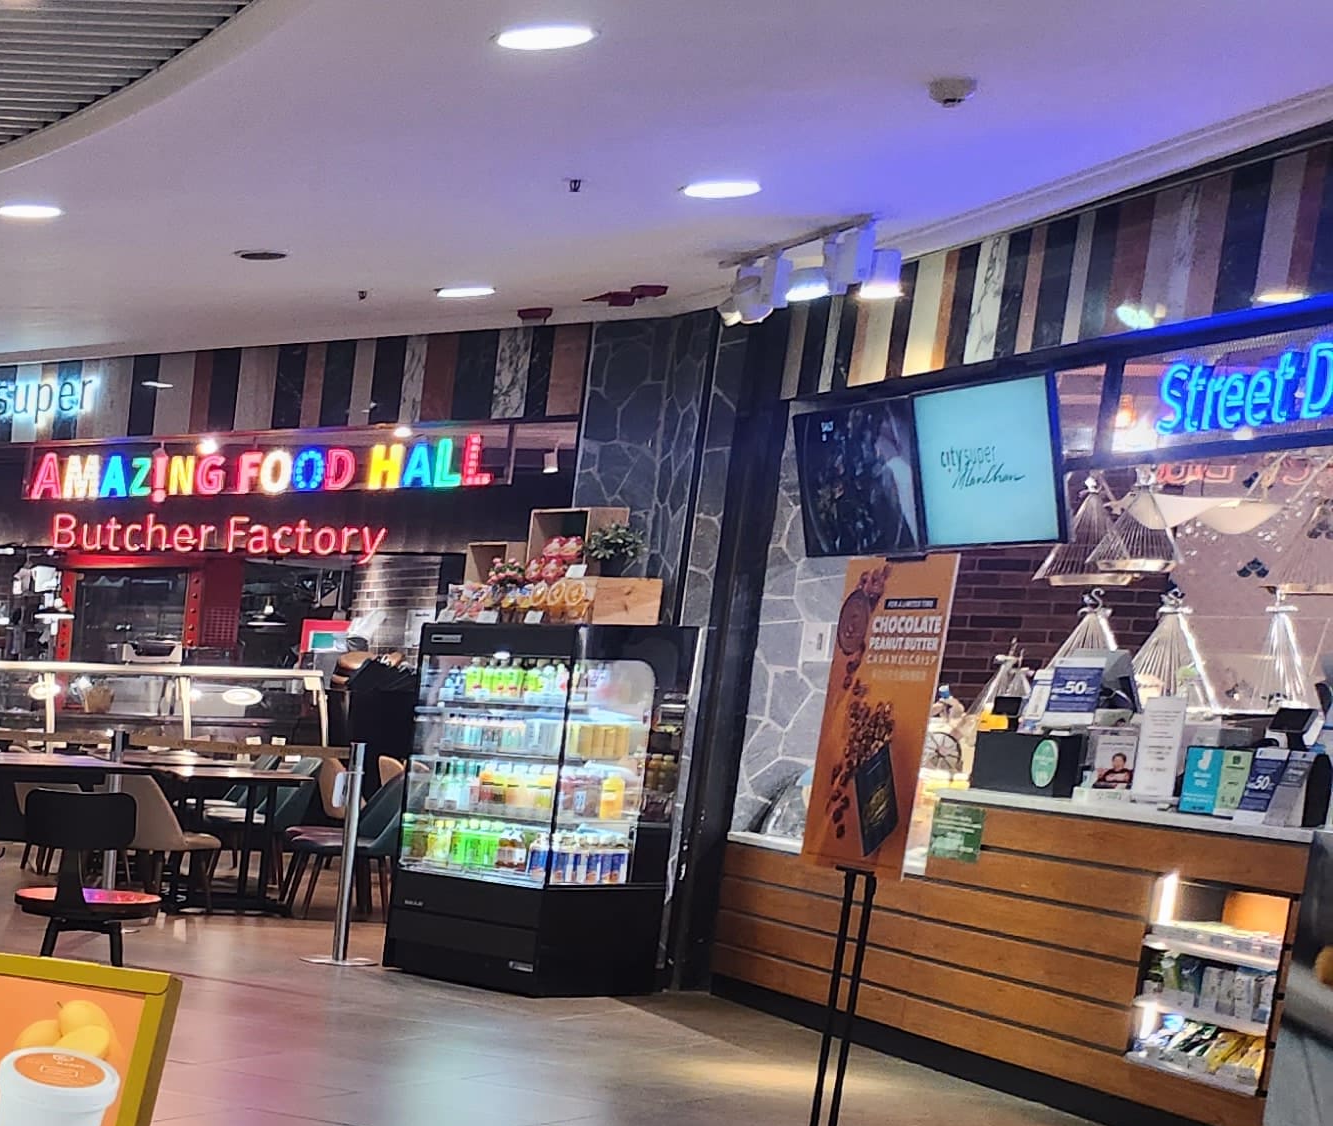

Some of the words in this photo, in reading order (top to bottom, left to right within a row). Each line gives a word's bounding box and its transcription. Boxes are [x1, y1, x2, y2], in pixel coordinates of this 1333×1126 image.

[1156, 350, 1296, 435] Street
[236, 447, 356, 495] FOOD
[368, 432, 493, 490] HALL
[52, 512, 216, 553] Butcher
[225, 515, 388, 565] Factory
[872, 615, 943, 634] CHOCOLATE
[869, 636, 904, 651] PEANUT
[904, 637, 939, 651] BUTTER
[1065, 681, 1088, 695] 50
[1255, 775, 1271, 790] 50
